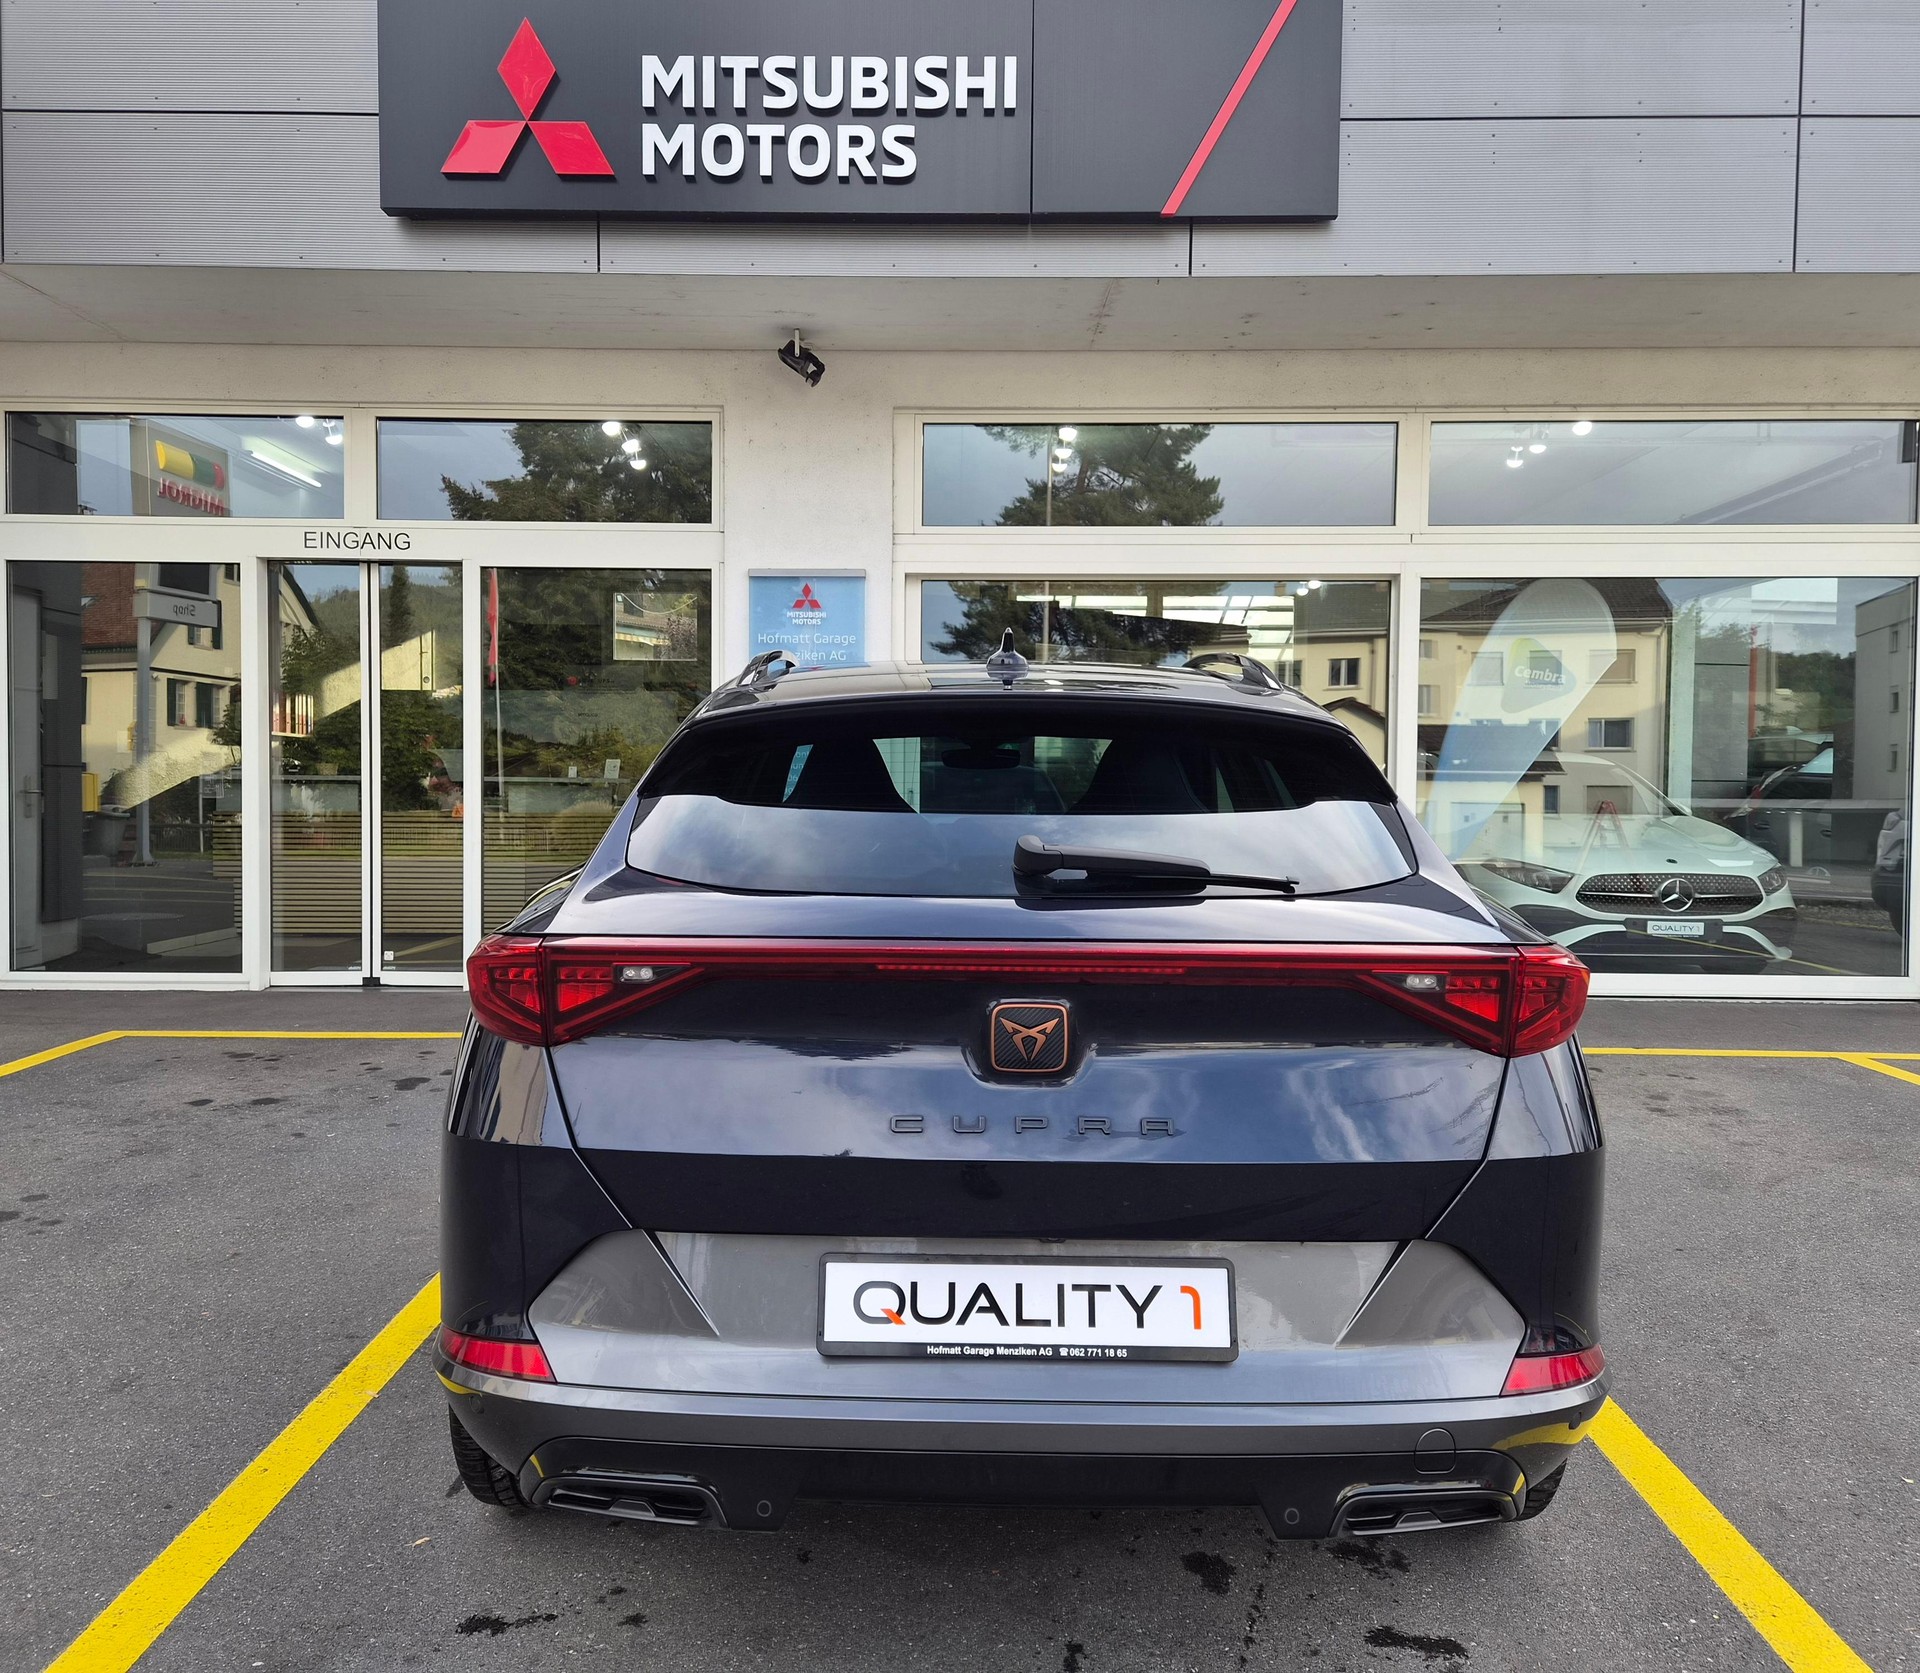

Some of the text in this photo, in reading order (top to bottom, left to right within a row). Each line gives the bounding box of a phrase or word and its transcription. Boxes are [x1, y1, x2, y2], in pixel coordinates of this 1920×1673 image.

[641, 54, 1018, 113] MITSUBISHI
[641, 122, 918, 180] MOTORS
[303, 531, 411, 550] EINGANG
[757, 633, 856, 646] Hofmatt Garage
[795, 650, 847, 661] ziken AG
[1514, 665, 1567, 684] Cembra
[1652, 924, 1695, 932] QUALITY
[889, 1115, 1175, 1136] CUPRA
[853, 1280, 1202, 1330] QUALITY 1
[927, 1345, 1128, 1358] Hofmatt Garage Menziken AG 062 771 18 65
